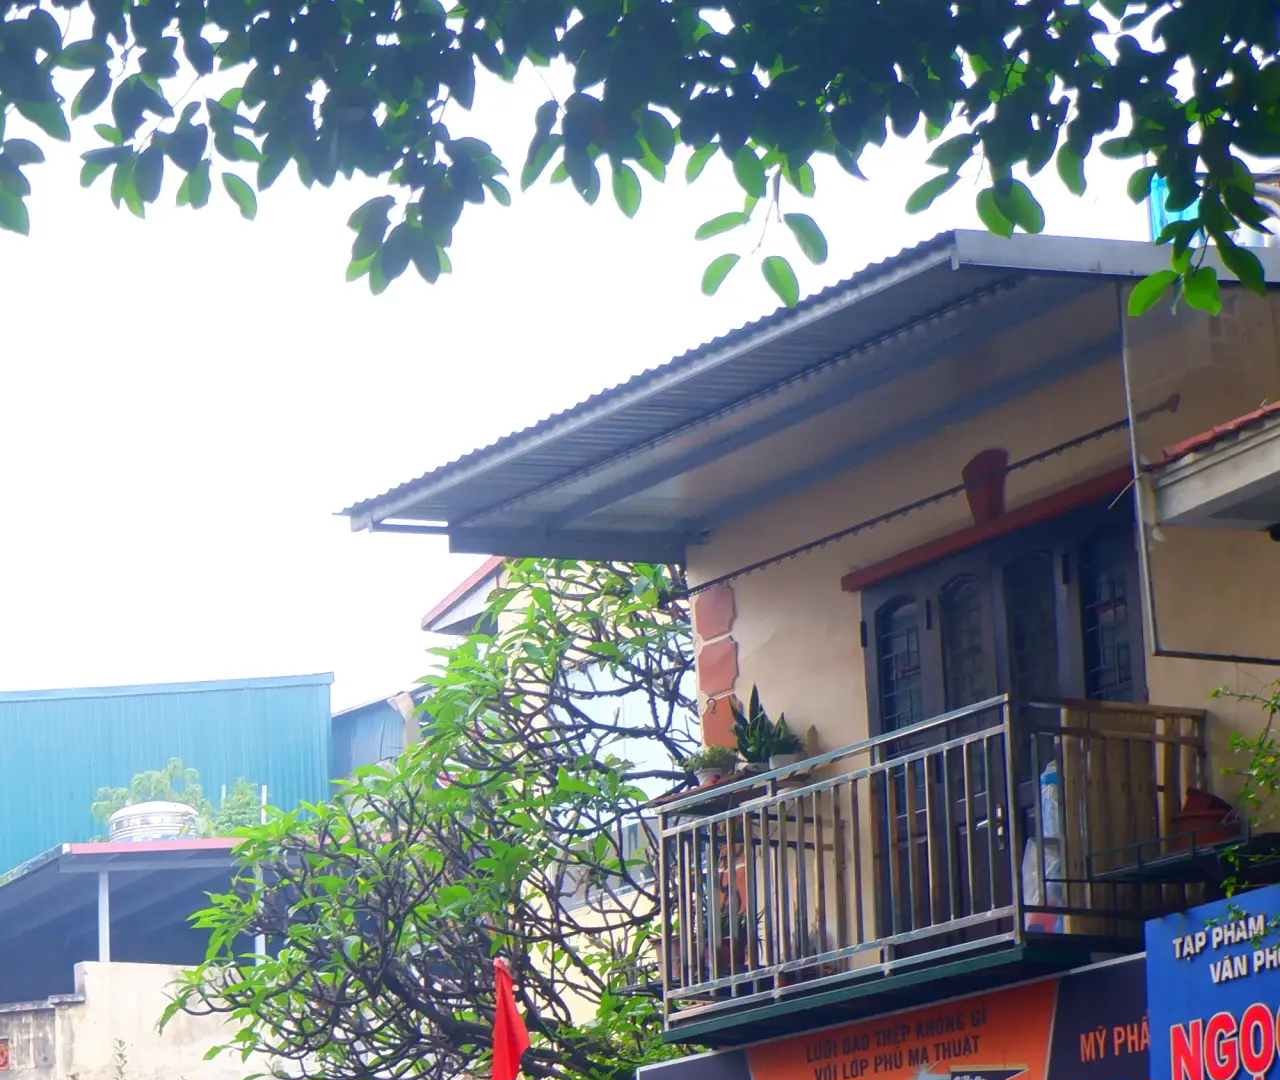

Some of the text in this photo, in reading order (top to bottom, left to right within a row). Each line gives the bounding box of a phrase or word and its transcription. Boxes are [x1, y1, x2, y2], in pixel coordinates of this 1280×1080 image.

[1172, 930, 1207, 961] TẠP
[1209, 952, 1249, 984] VĂN
[842, 1034, 870, 1055] DAO
[915, 1012, 966, 1039] KHÔNG
[1079, 1025, 1108, 1063] MỸ
[842, 1055, 870, 1080] LỚP
[874, 1045, 904, 1074] PHỦ
[908, 1046, 931, 1067] MA
[935, 1034, 981, 1062] THUẬT
